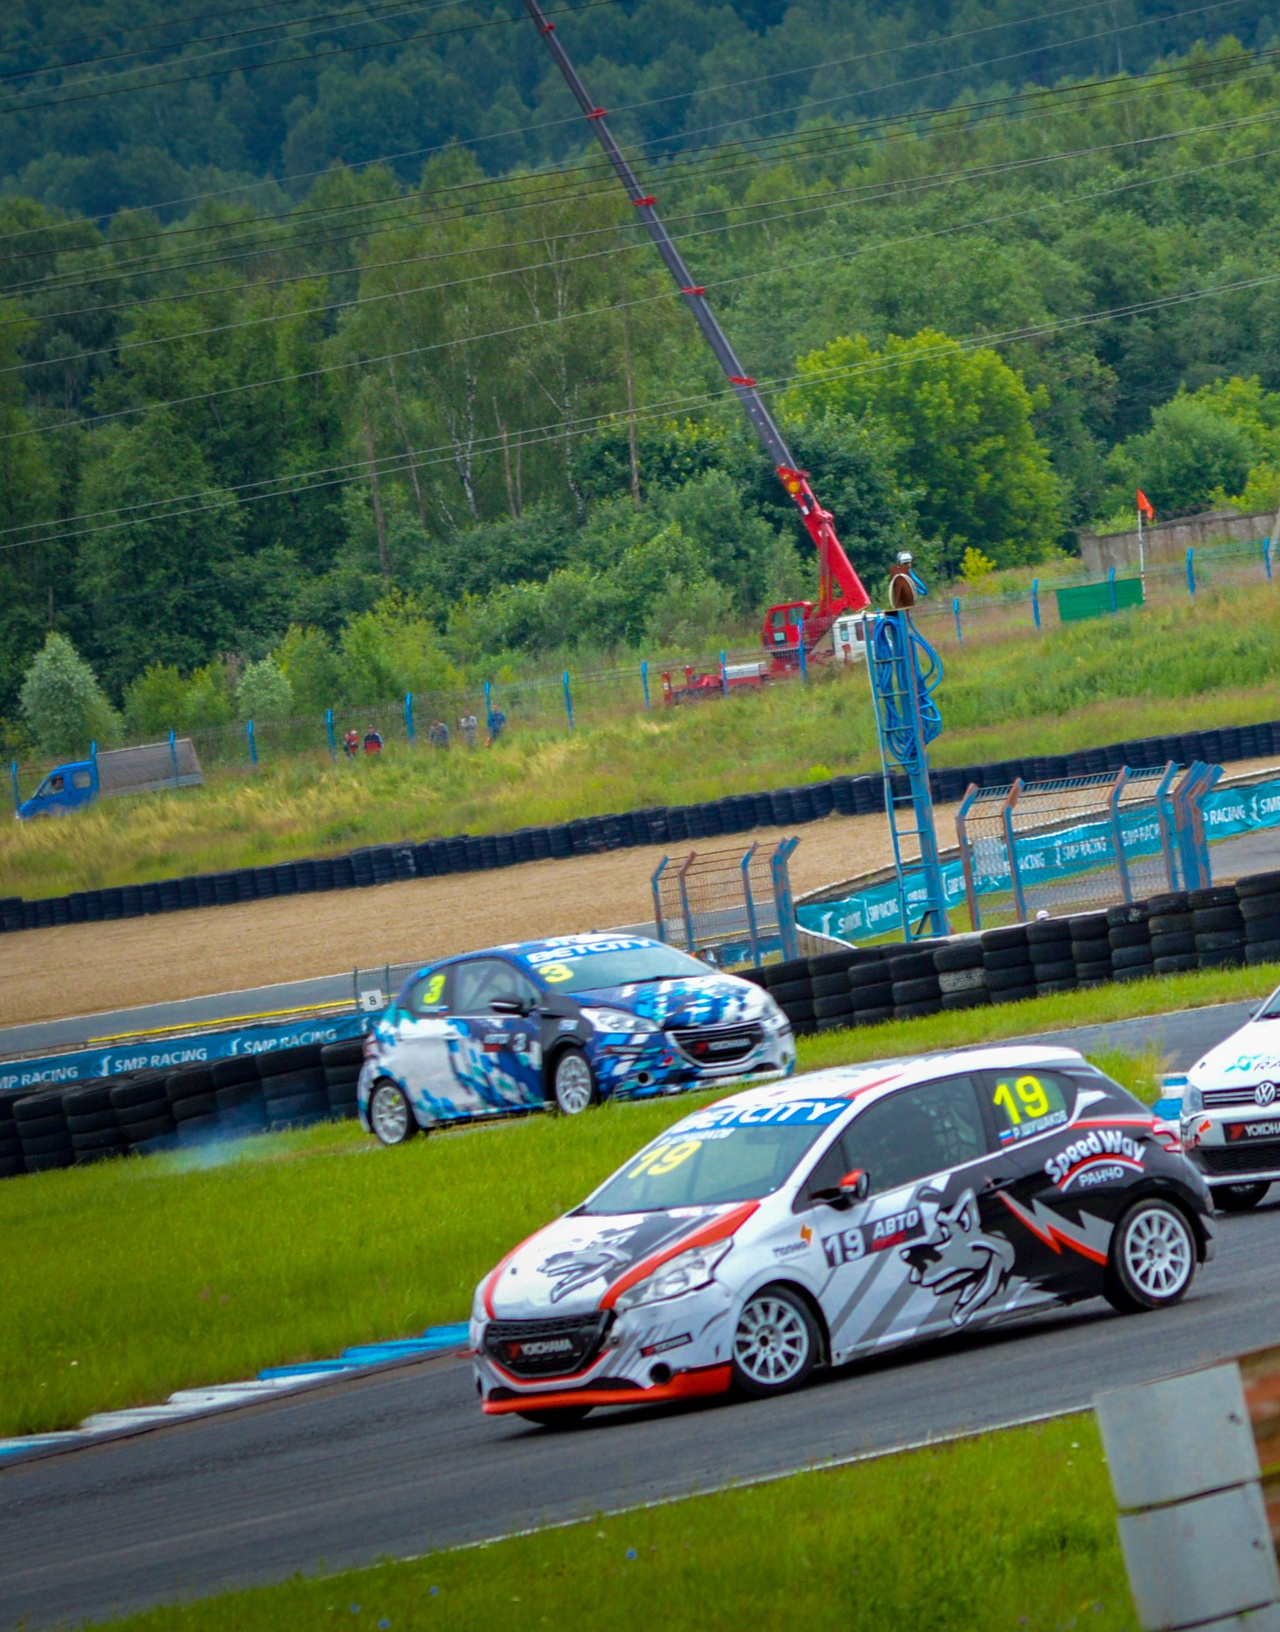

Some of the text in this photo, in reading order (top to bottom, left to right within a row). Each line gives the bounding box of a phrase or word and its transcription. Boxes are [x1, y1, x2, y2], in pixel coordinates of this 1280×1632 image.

[1209, 804, 1246, 825] RACING
[526, 939, 652, 963] BETCITY
[538, 963, 574, 983] 3
[423, 974, 446, 1004] 3
[243, 1029, 337, 1054] SMP RACING
[114, 1048, 208, 1073] SMP RACING
[21, 1066, 79, 1085] RACING
[993, 1074, 1049, 1124] 19
[671, 1101, 846, 1134] BETCITY
[628, 1141, 703, 1179] 19
[1078, 1166, 1125, 1187] РАНЧО
[825, 1228, 866, 1267] 19
